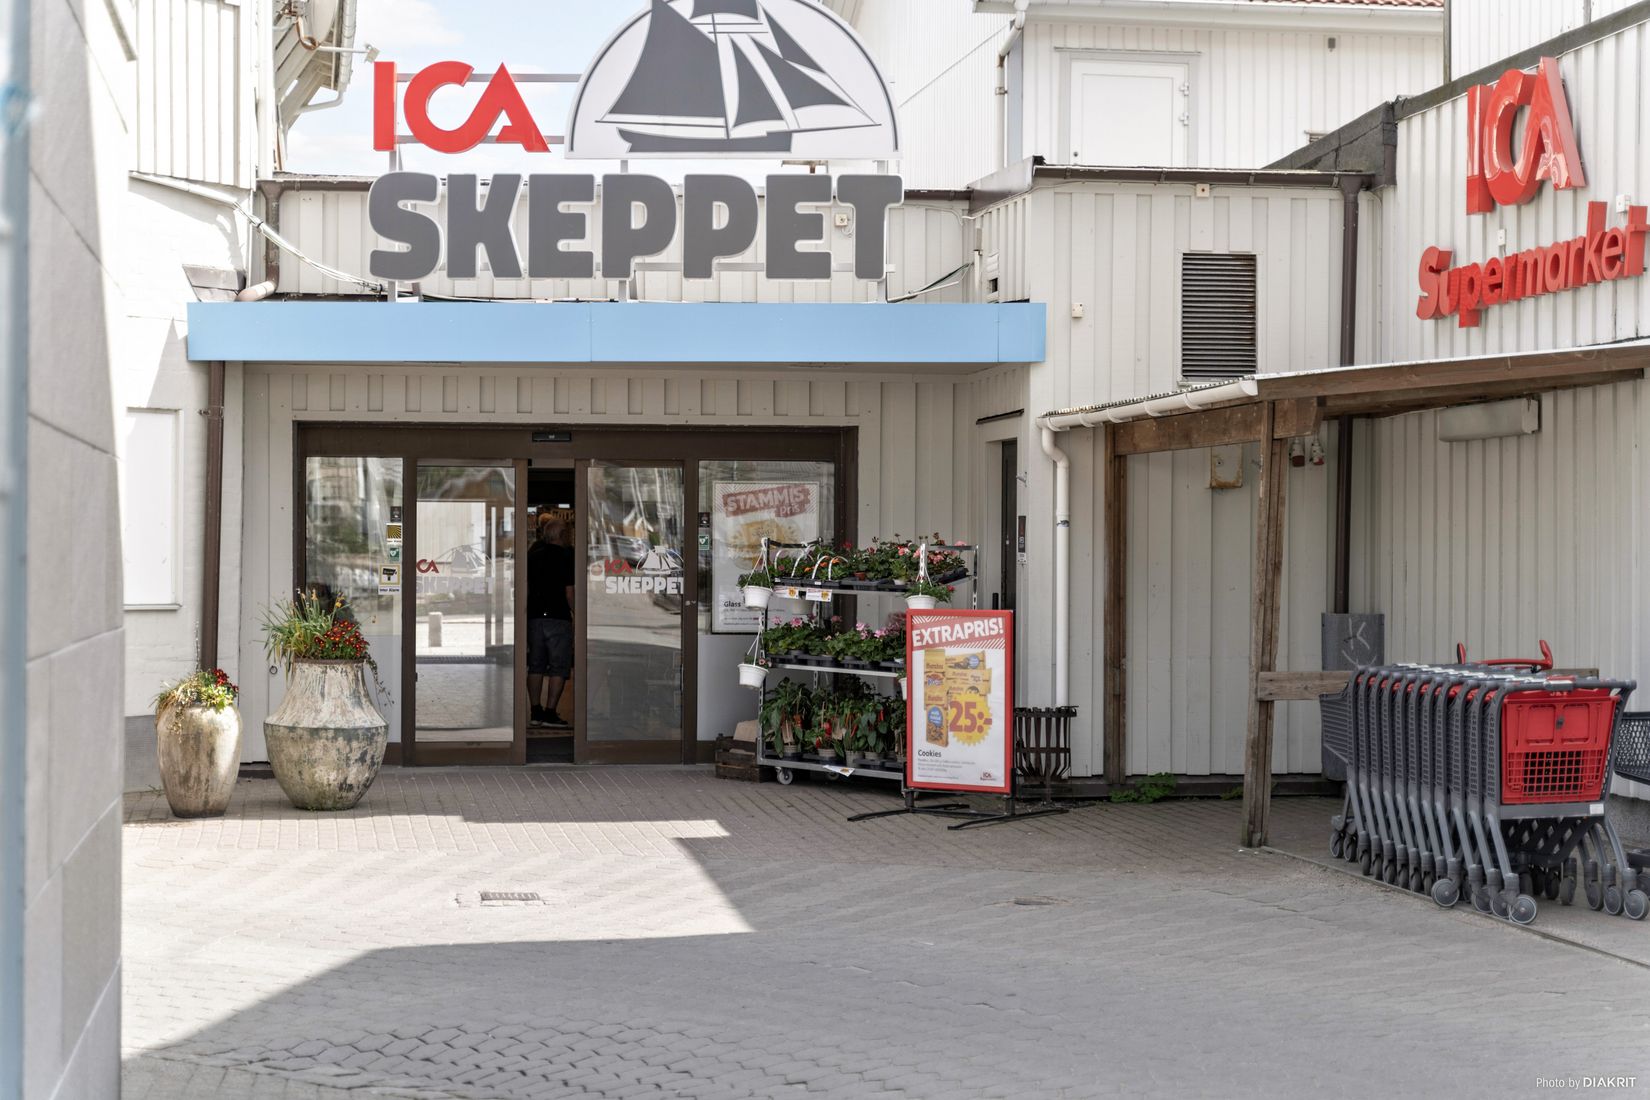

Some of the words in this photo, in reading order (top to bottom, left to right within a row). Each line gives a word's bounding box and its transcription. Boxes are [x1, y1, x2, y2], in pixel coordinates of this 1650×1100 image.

[373, 60, 551, 154] ICA
[1466, 56, 1587, 215] ICA
[368, 171, 904, 281] SKEPPET
[1416, 201, 1650, 328] Supermarket
[726, 487, 804, 512] STAMMIS
[780, 503, 801, 514] pris
[416, 559, 439, 573] CA
[604, 559, 633, 575] ICA
[911, 617, 1004, 647] EXTRAPRIS!
[918, 749, 942, 758] Cookies
